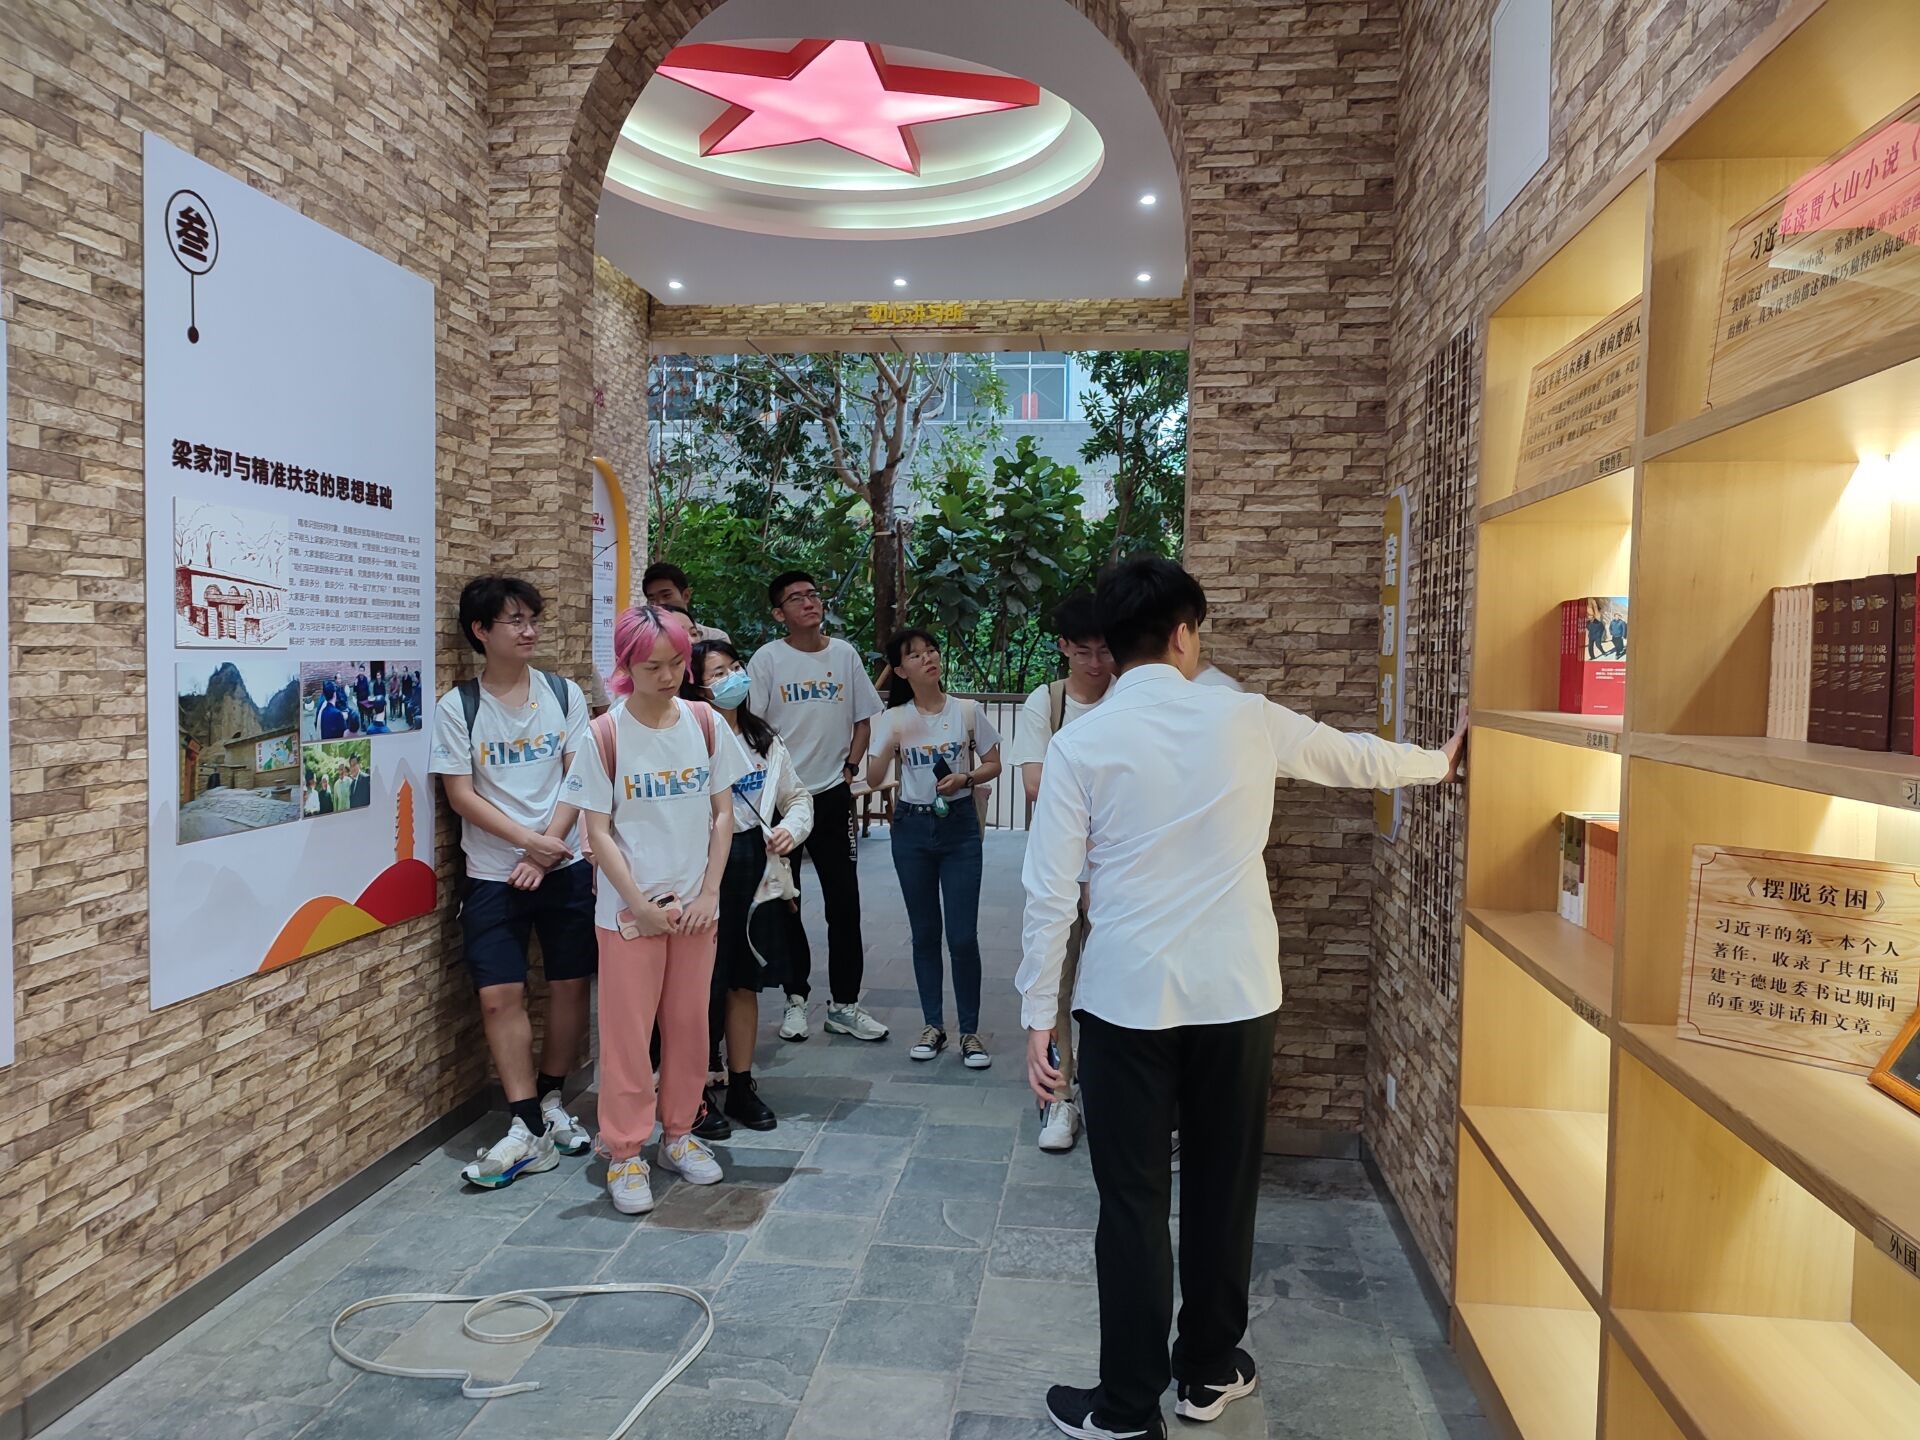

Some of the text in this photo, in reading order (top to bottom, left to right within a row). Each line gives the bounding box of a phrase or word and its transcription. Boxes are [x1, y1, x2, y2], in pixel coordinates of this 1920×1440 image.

[175, 206, 209, 263] 叁
[172, 438, 393, 510] 梁家河与精准扶贫的思想基础
[480, 731, 566, 767] HITSZ
[1746, 876, 1886, 913] 《摆脱贫困》
[1714, 917, 1900, 957] 习近平的第一本个人
[1709, 966, 1896, 1012] 建宁德地委书记期间
[1707, 991, 1883, 1037] 的重要讲话和文章。
[1889, 1234, 1917, 1273] 外国
